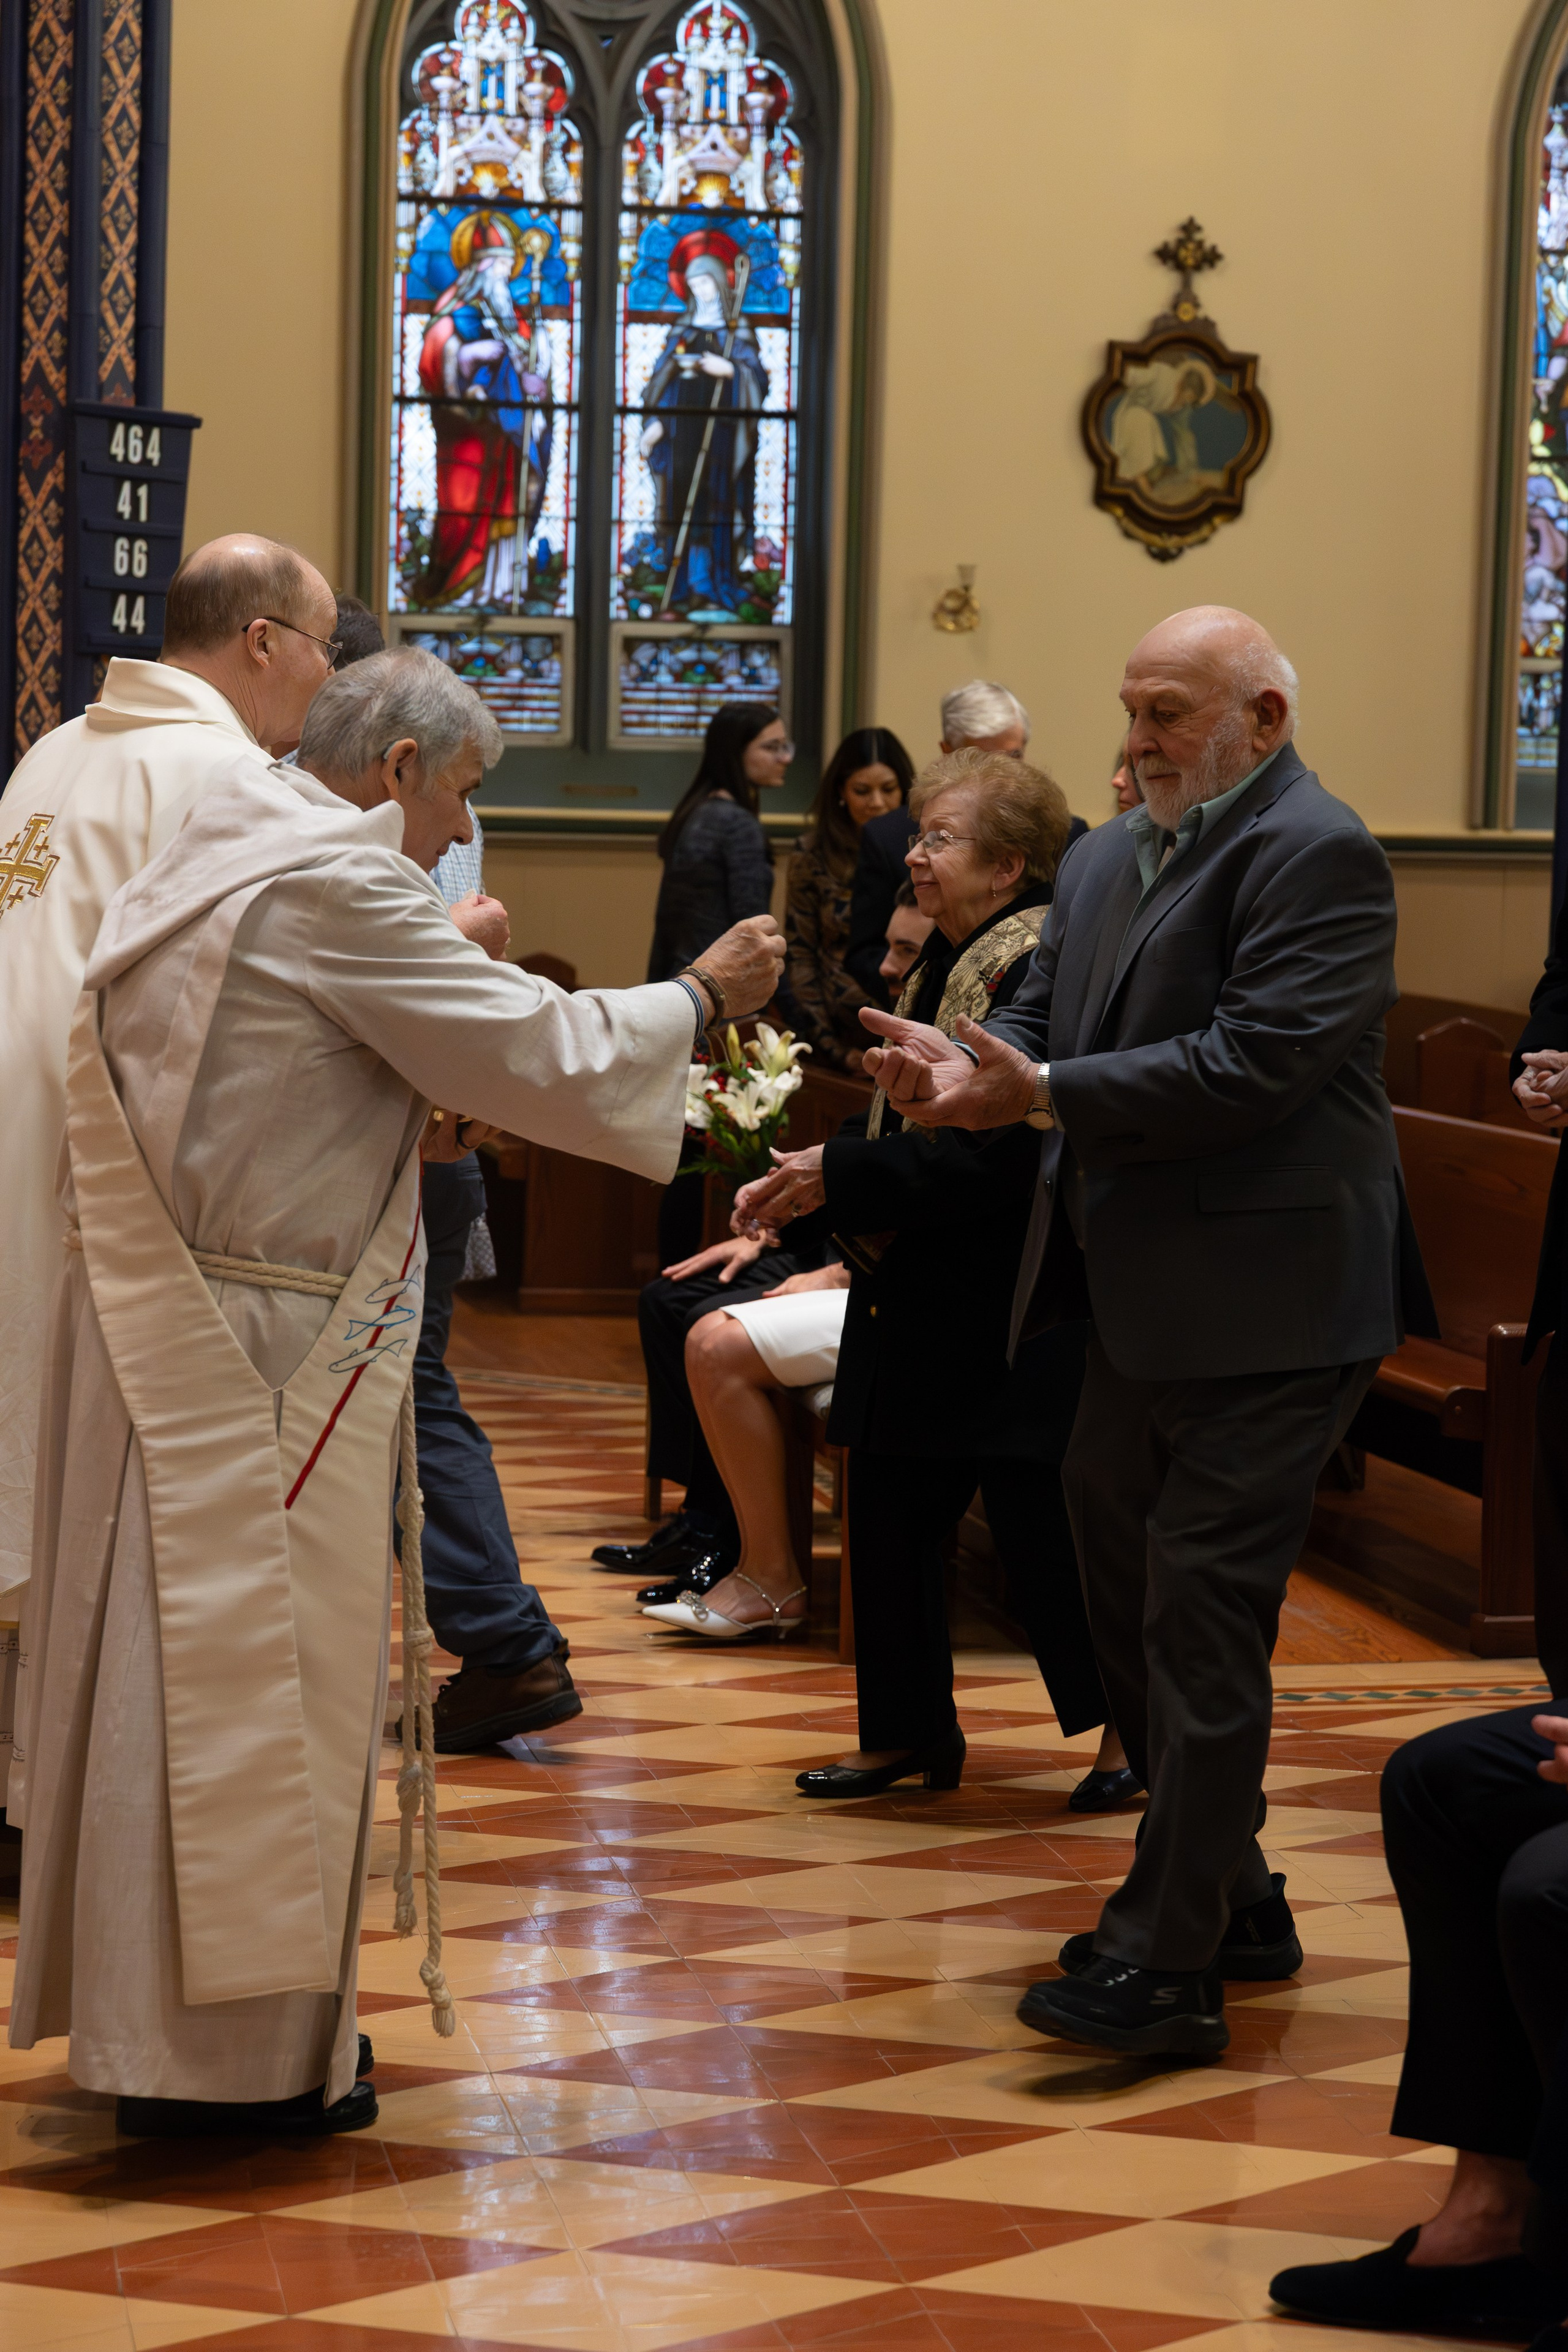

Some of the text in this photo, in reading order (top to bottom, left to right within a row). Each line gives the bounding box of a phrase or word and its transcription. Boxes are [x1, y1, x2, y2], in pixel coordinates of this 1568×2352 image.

[110, 422, 161, 467] 464
[116, 480, 148, 522] 41
[113, 537, 148, 578] 66
[111, 593, 145, 635] 44
